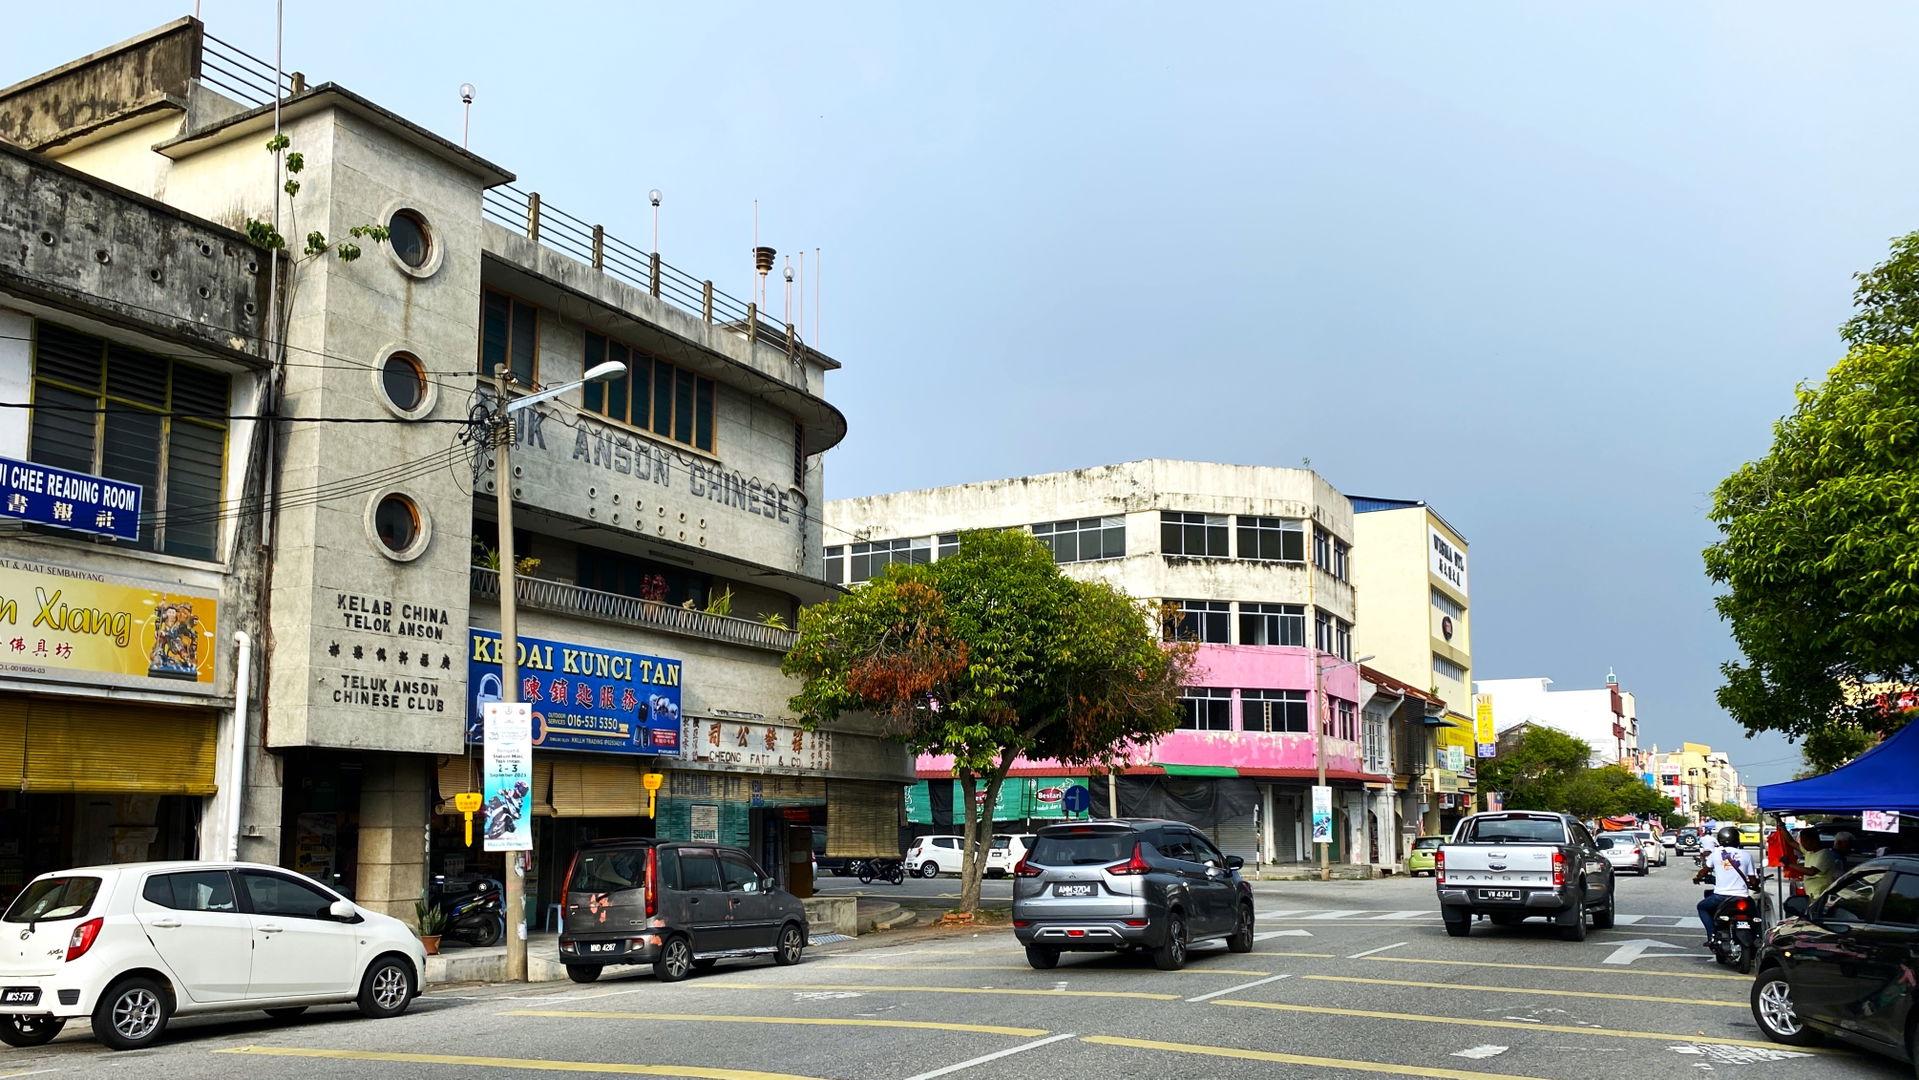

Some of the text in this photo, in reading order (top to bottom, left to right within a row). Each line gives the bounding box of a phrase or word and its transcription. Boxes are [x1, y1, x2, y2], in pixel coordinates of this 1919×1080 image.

[572, 424, 670, 487] ANSON
[689, 463, 789, 524] CHINESE
[11, 466, 43, 493] CHEE
[47, 473, 99, 504] READING
[103, 485, 135, 512] ROOM
[12, 561, 20, 570] &
[23, 563, 43, 574] ALAT
[47, 566, 105, 583] SEMBAHYANG
[32, 586, 132, 648] Xiang
[337, 594, 448, 625] KELAB CHINA
[343, 613, 443, 640] TELOK ANSON
[0, 636, 73, 659] 佛具坊
[473, 635, 680, 687] KEDAI KUNCI TAN
[341, 674, 438, 697] TELUK ANSON
[523, 675, 638, 713] 陳鎖匙服務
[333, 690, 444, 712] CHINESE CLUB
[567, 713, 618, 730] 016-531 5350
[511, 764, 518, 773] 3
[709, 751, 741, 763] CHEONG
[778, 755, 784, 767] &
